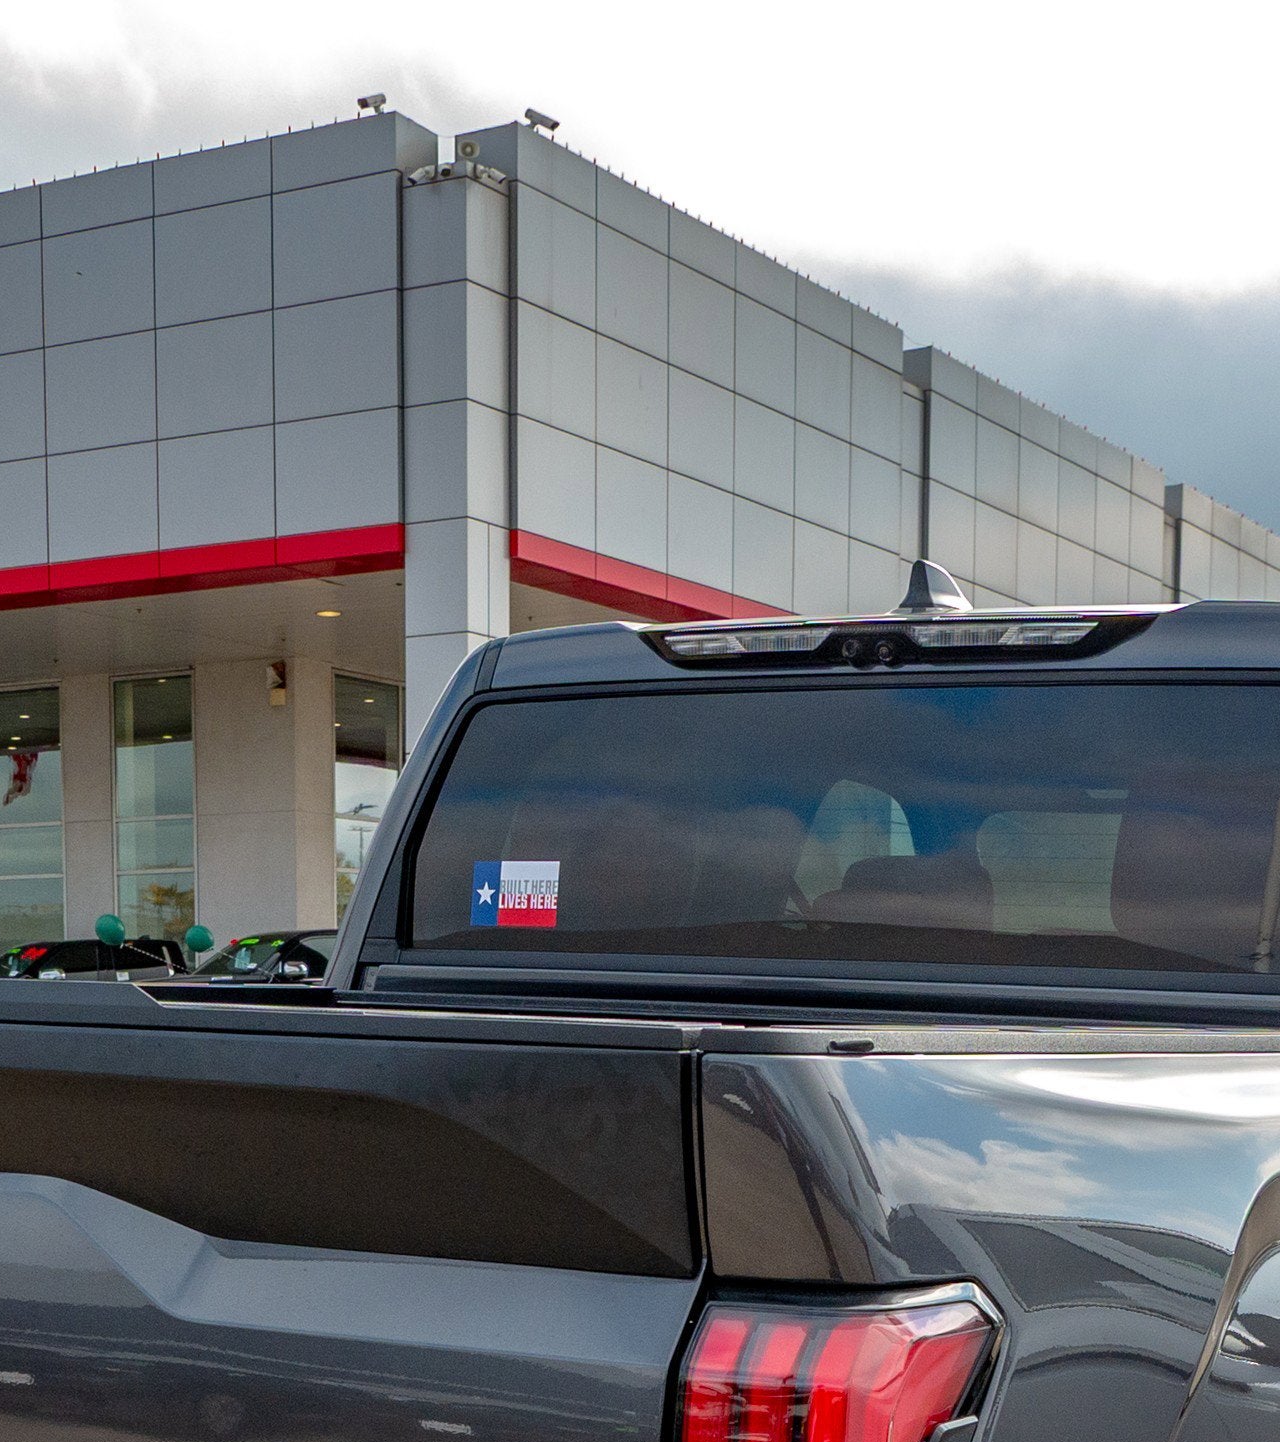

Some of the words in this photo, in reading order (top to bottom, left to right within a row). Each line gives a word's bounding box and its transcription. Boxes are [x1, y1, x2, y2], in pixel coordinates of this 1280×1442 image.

[500, 879, 529, 895] BUILT
[533, 880, 559, 895] HERE
[498, 893, 529, 909] LIVES
[530, 894, 558, 910] HERE
